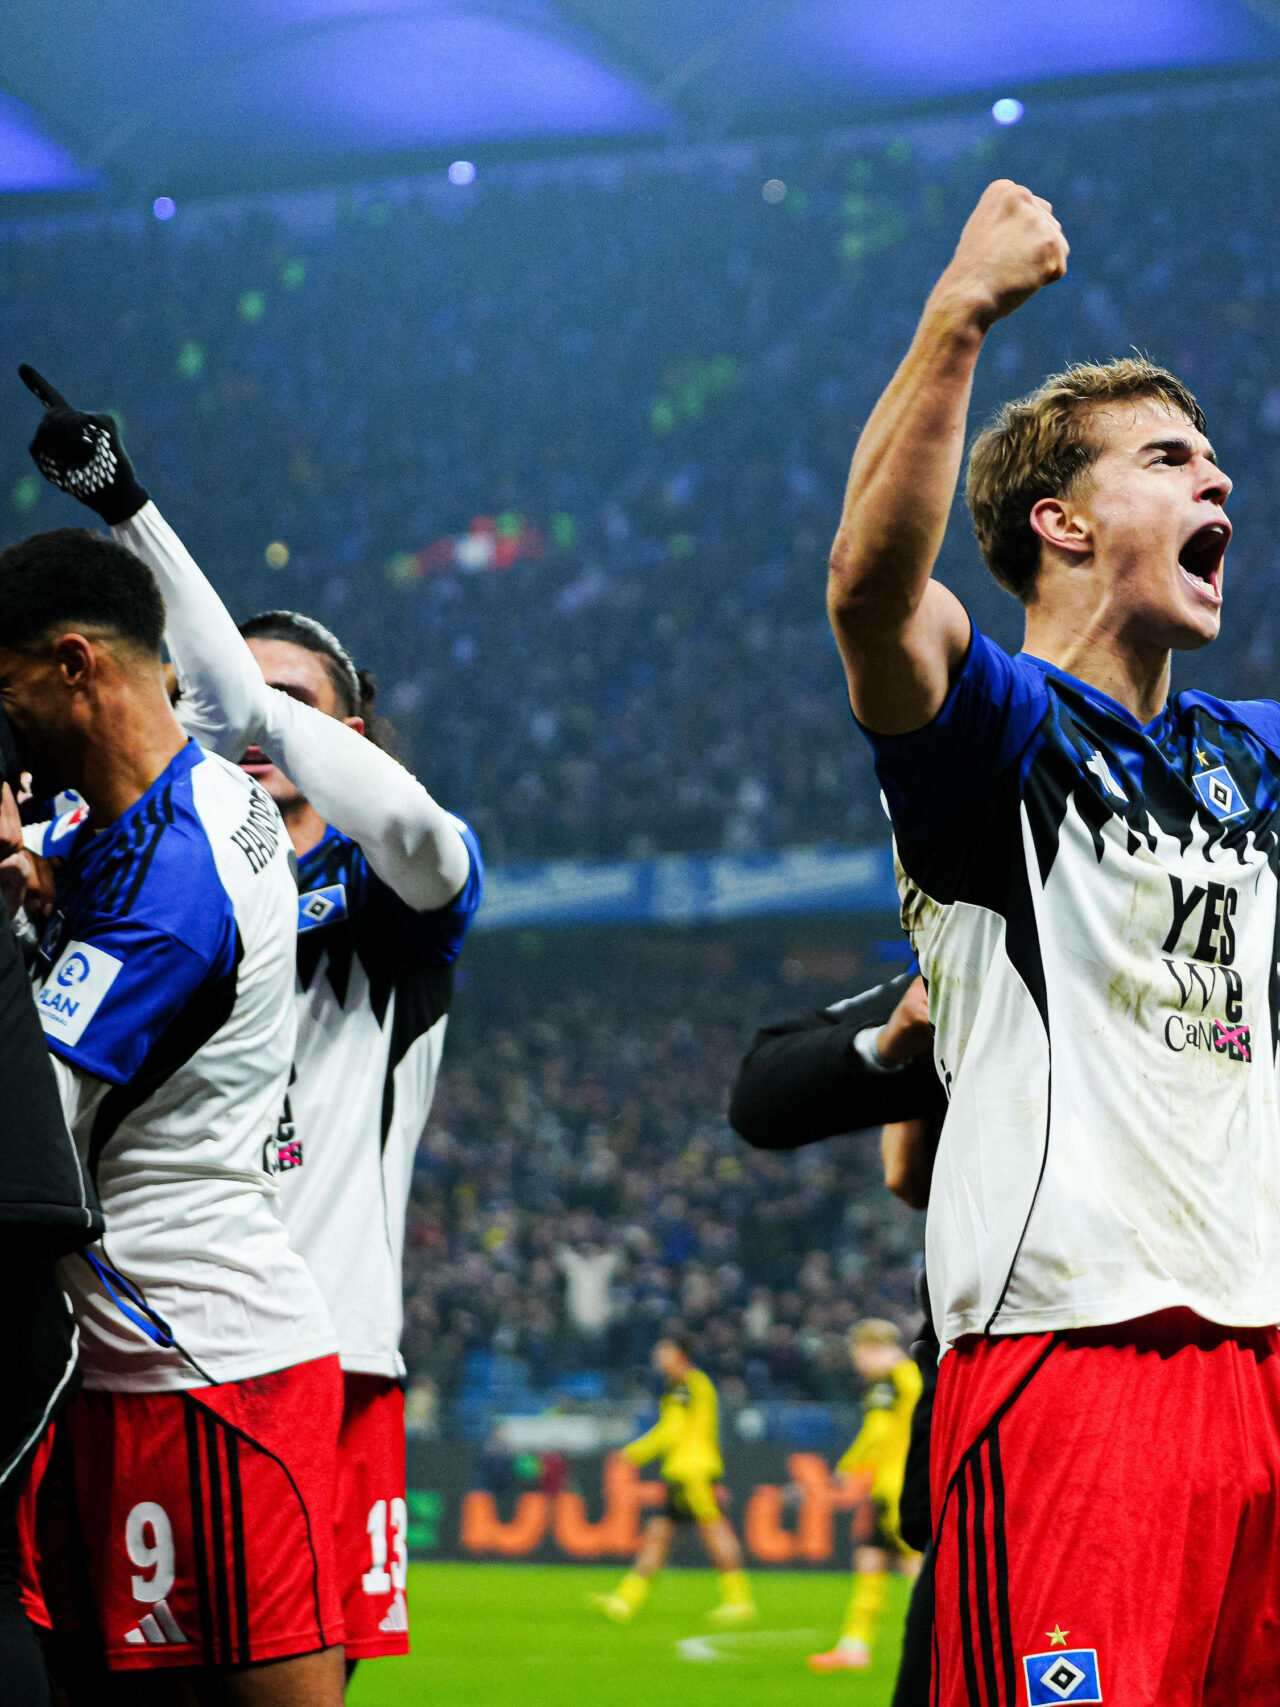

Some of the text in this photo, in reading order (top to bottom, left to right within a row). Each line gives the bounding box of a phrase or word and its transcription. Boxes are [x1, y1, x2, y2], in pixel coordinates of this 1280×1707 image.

[1162, 873, 1238, 966] YES
[1162, 958, 1243, 1024] We
[126, 1502, 175, 1602] 9
[363, 1497, 407, 1594] 13
